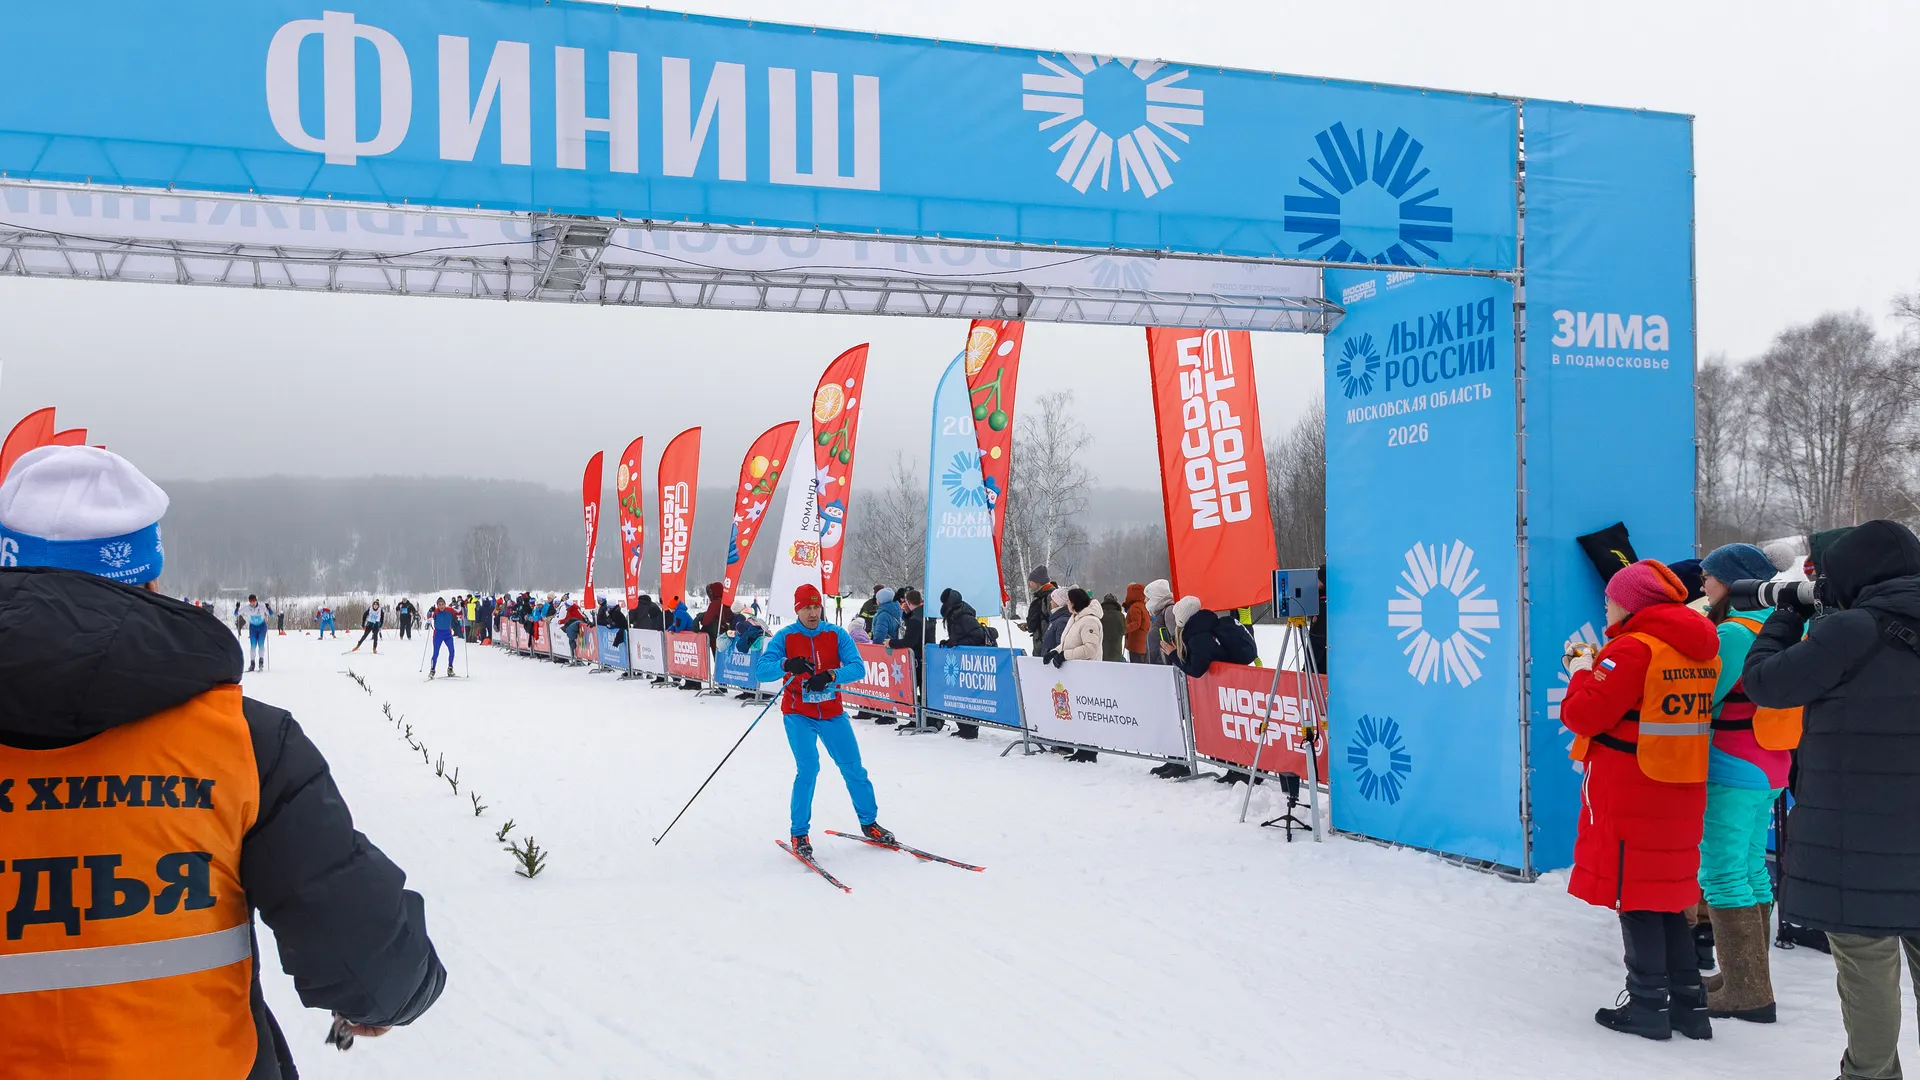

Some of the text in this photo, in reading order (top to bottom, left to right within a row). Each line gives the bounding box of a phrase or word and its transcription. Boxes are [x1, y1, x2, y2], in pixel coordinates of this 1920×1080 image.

[265, 10, 880, 191] ФИНИШ
[1342, 279, 1376, 298] МОСОБЛ
[1342, 289, 1369, 305] СПОРТ
[1386, 296, 1495, 358] ЛЫЖНЯ
[1386, 336, 1495, 392] РОССИИ
[1565, 354, 1669, 369] подмосковье
[1346, 382, 1492, 424] МОСКОВСКАЯ ОБЛАСТЬ
[942, 415, 974, 436] 20
[1176, 336, 1222, 530] МОСОБЛ
[1388, 422, 1429, 447] 2026
[1205, 369, 1252, 523] СПОРТ
[801, 478, 818, 531] КОМАНДА
[661, 485, 675, 574] МОСОБЛ
[673, 503, 688, 574] СПОРТ
[959, 671, 996, 692] РОССИИ
[960, 653, 996, 674] ЛЫЖНЯ
[1662, 668, 1696, 682] ЦПСК
[1076, 695, 1119, 709] КОМАНДА
[1078, 710, 1139, 727] ГУБЕРНАТОРА
[1661, 693, 1713, 719] СУДЬ
[1221, 713, 1298, 751] СПОРТ
[26, 774, 215, 812] ХИМКИ
[0, 851, 217, 941] ДЬЯ
